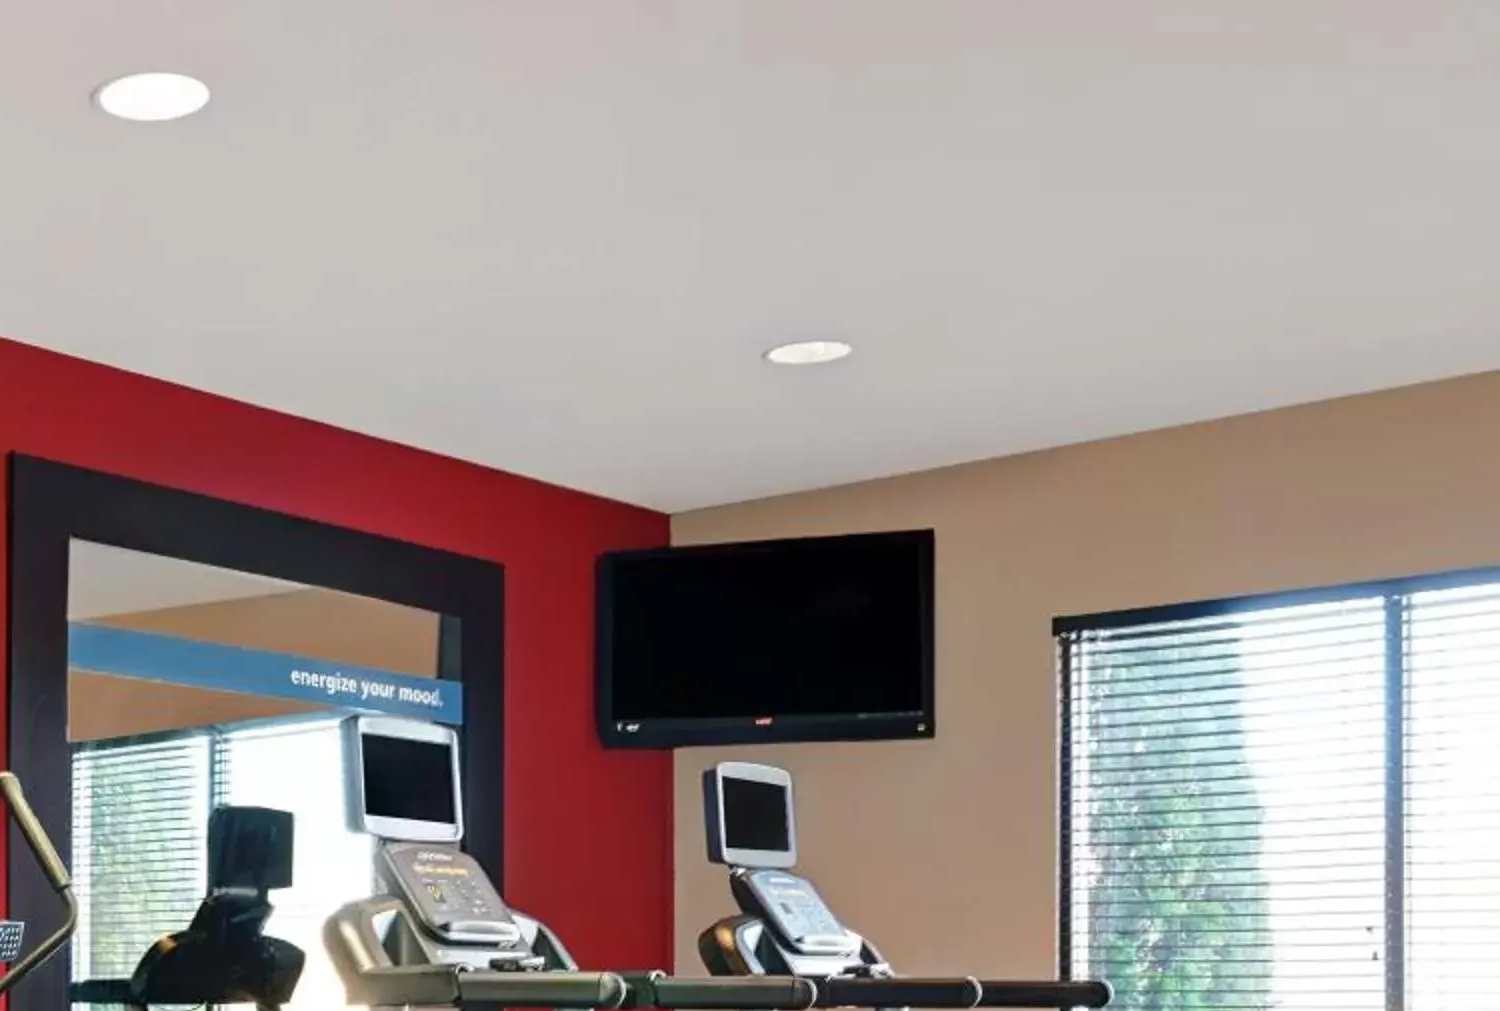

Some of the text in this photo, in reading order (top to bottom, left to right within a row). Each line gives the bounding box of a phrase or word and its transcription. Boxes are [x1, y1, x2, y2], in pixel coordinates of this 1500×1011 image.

[291, 669, 444, 707] energize your mood.
